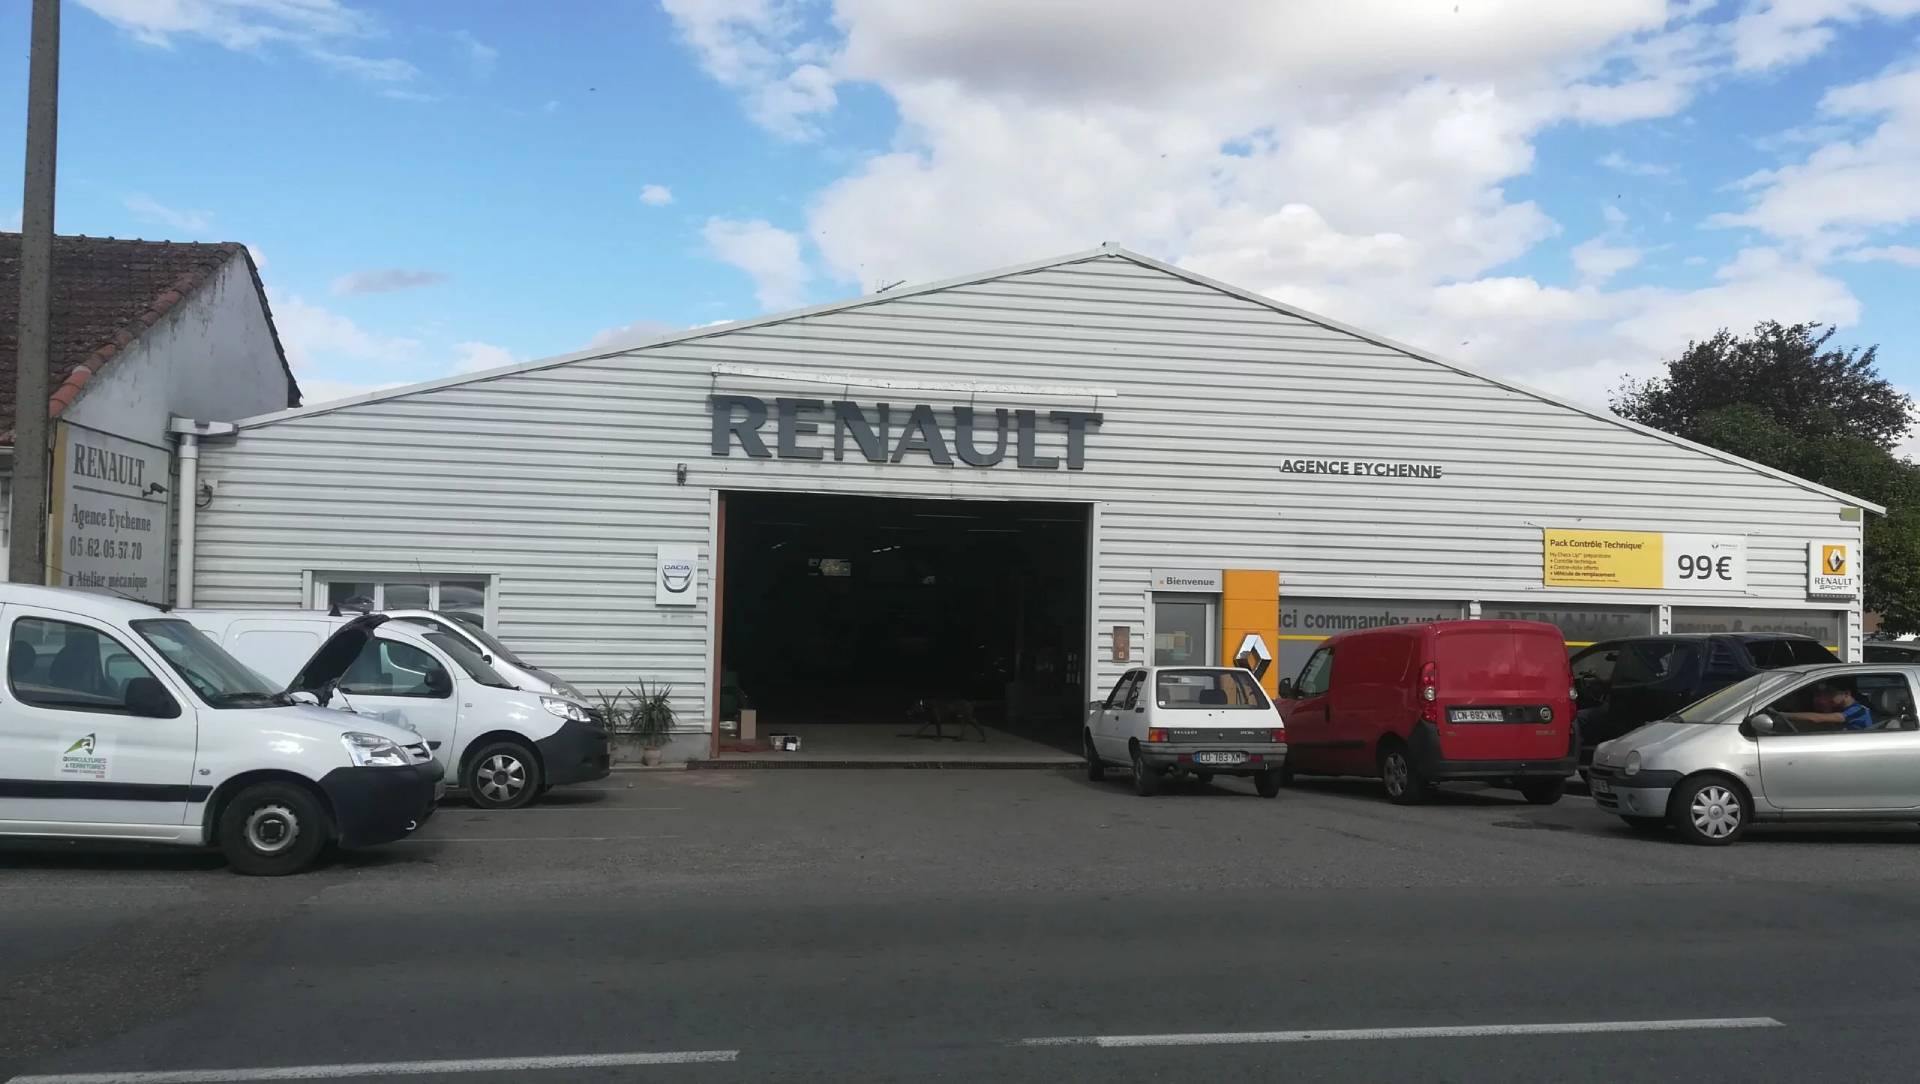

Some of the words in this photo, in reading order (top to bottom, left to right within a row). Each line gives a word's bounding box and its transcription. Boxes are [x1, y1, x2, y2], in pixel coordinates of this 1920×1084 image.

[708, 394, 1104, 470] RENAULT
[73, 443, 145, 488] RENAULT
[1280, 459, 1350, 475] AGENCE
[1353, 462, 1443, 479] EYCHENNE
[71, 503, 107, 530] Agence
[108, 508, 151, 533] Eychenne
[1550, 539, 1568, 547] Pack
[1569, 539, 1602, 548] Contrôle
[1678, 554, 1732, 580] 99€
[76, 570, 106, 588] Atelier
[1166, 576, 1215, 586] Bienvenue
[1814, 577, 1853, 585] RENAULT
[1279, 609, 1297, 628] ici
